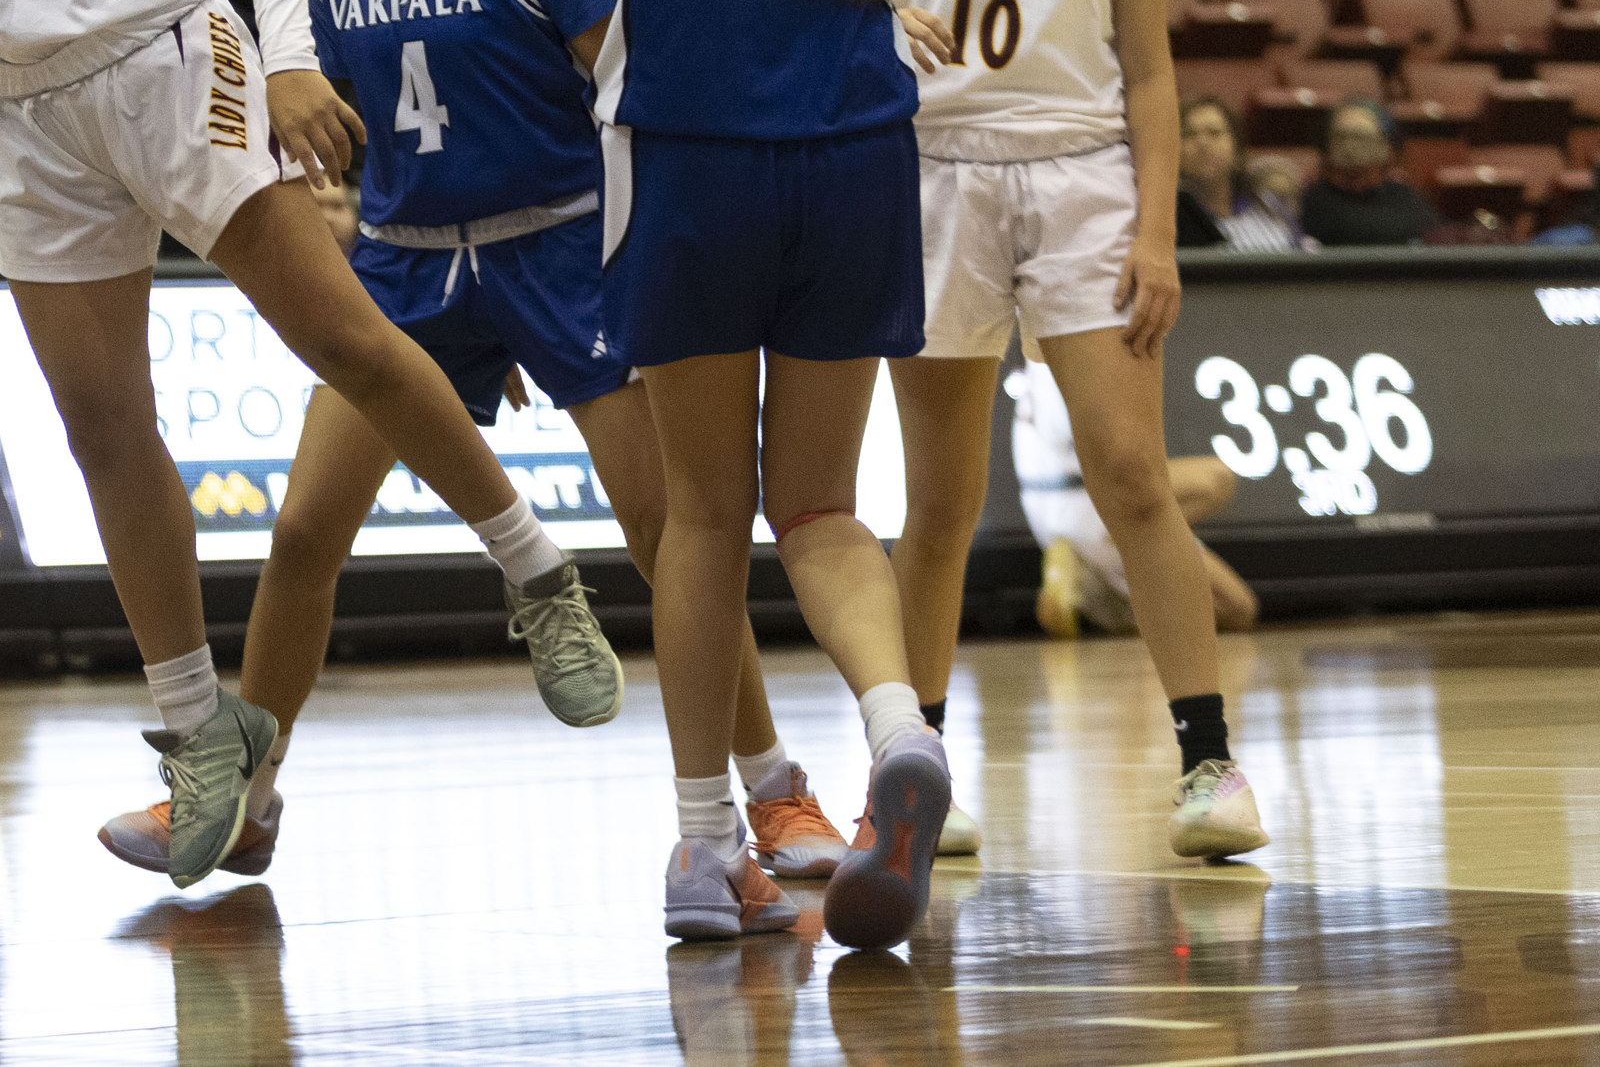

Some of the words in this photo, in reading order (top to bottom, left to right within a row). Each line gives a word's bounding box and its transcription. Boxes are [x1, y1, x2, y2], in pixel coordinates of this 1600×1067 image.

[207, 11, 247, 89] CHIEFS
[394, 39, 451, 155] 4
[207, 86, 249, 152] LADY
[1195, 352, 1434, 480] 3:36
